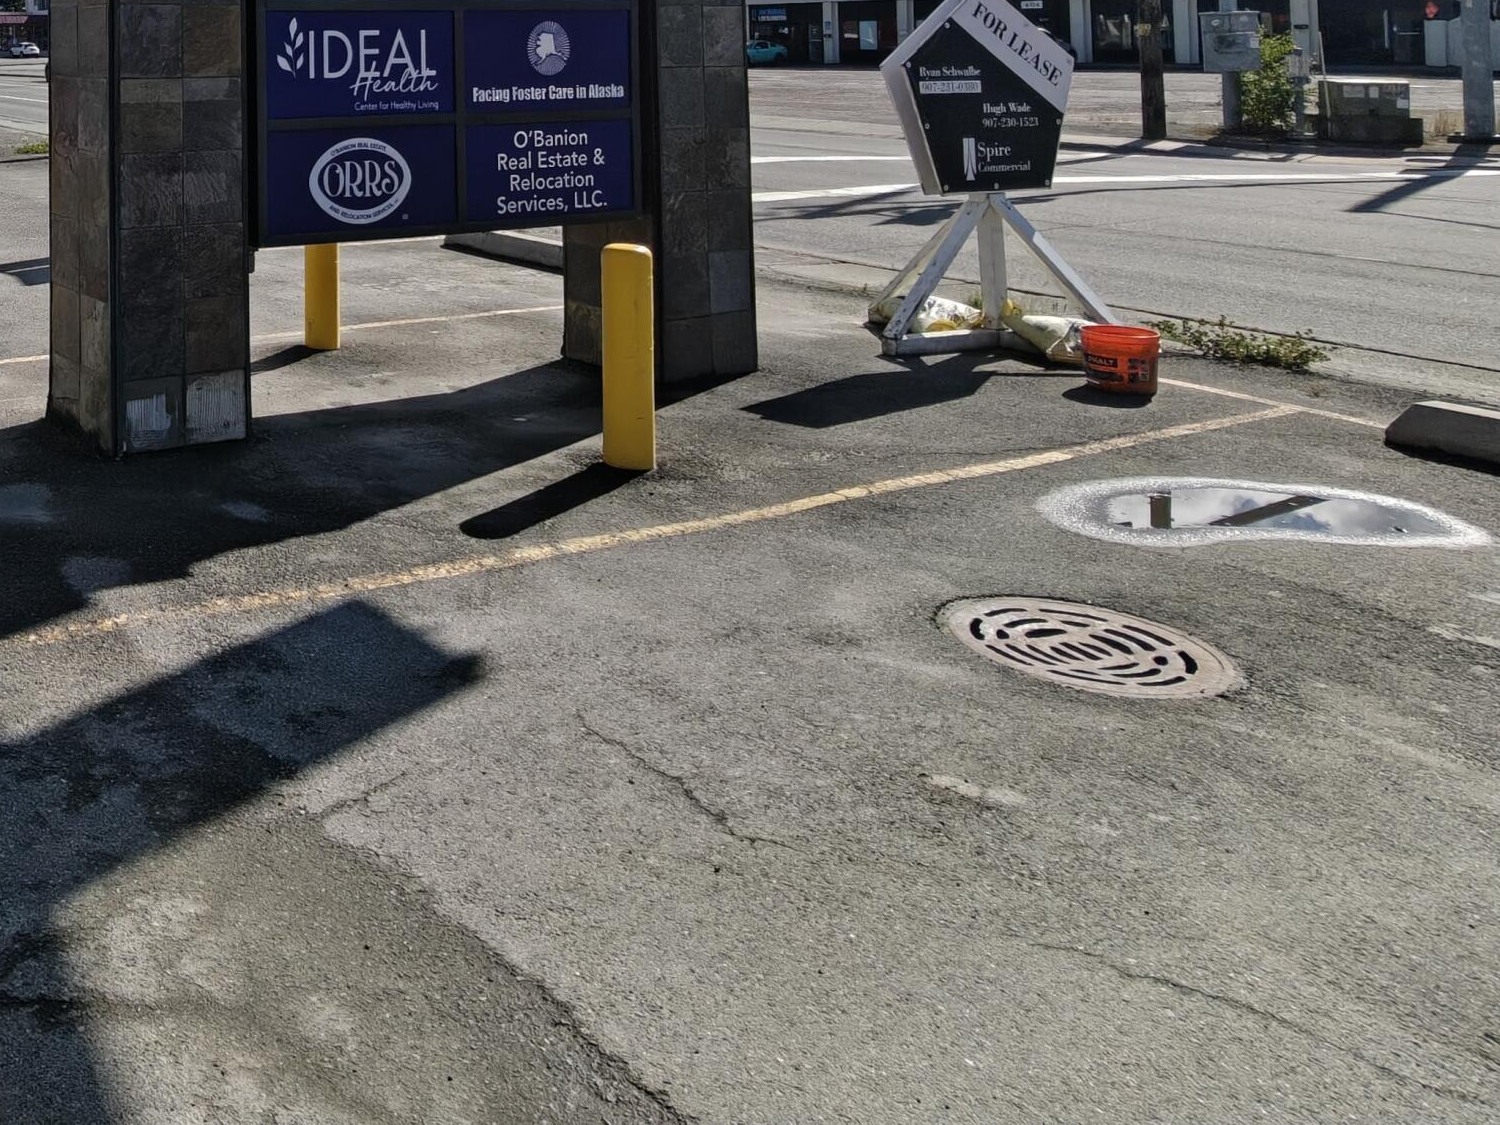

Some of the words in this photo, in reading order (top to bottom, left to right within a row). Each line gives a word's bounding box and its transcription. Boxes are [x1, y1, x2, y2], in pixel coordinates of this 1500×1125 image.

[308, 28, 437, 79] IDEAL
[972, 2, 1007, 41] FOR
[1007, 31, 1062, 87] LEASE
[350, 60, 439, 101] Health
[919, 66, 941, 80] Ryan
[472, 87, 510, 103] Facing
[512, 86, 547, 101] Foster
[548, 85, 574, 100] Care
[576, 84, 587, 99] in
[588, 83, 625, 99] Alaska
[354, 101, 378, 111] Center
[379, 100, 389, 110] for
[390, 100, 417, 112] Healthy
[417, 100, 439, 111] Living
[982, 102, 1007, 116] Hugh
[1008, 102, 1032, 113] Wade
[513, 129, 589, 149] O'Banion
[497, 150, 532, 171] Real
[537, 151, 588, 169] Estate
[593, 147, 605, 166] &
[977, 142, 1011, 162] Spire
[978, 160, 1031, 173] Commercial
[322, 159, 399, 198] ORRS
[509, 171, 594, 192] Relocation
[496, 194, 569, 215] Services,
[574, 190, 608, 209] LLC.
